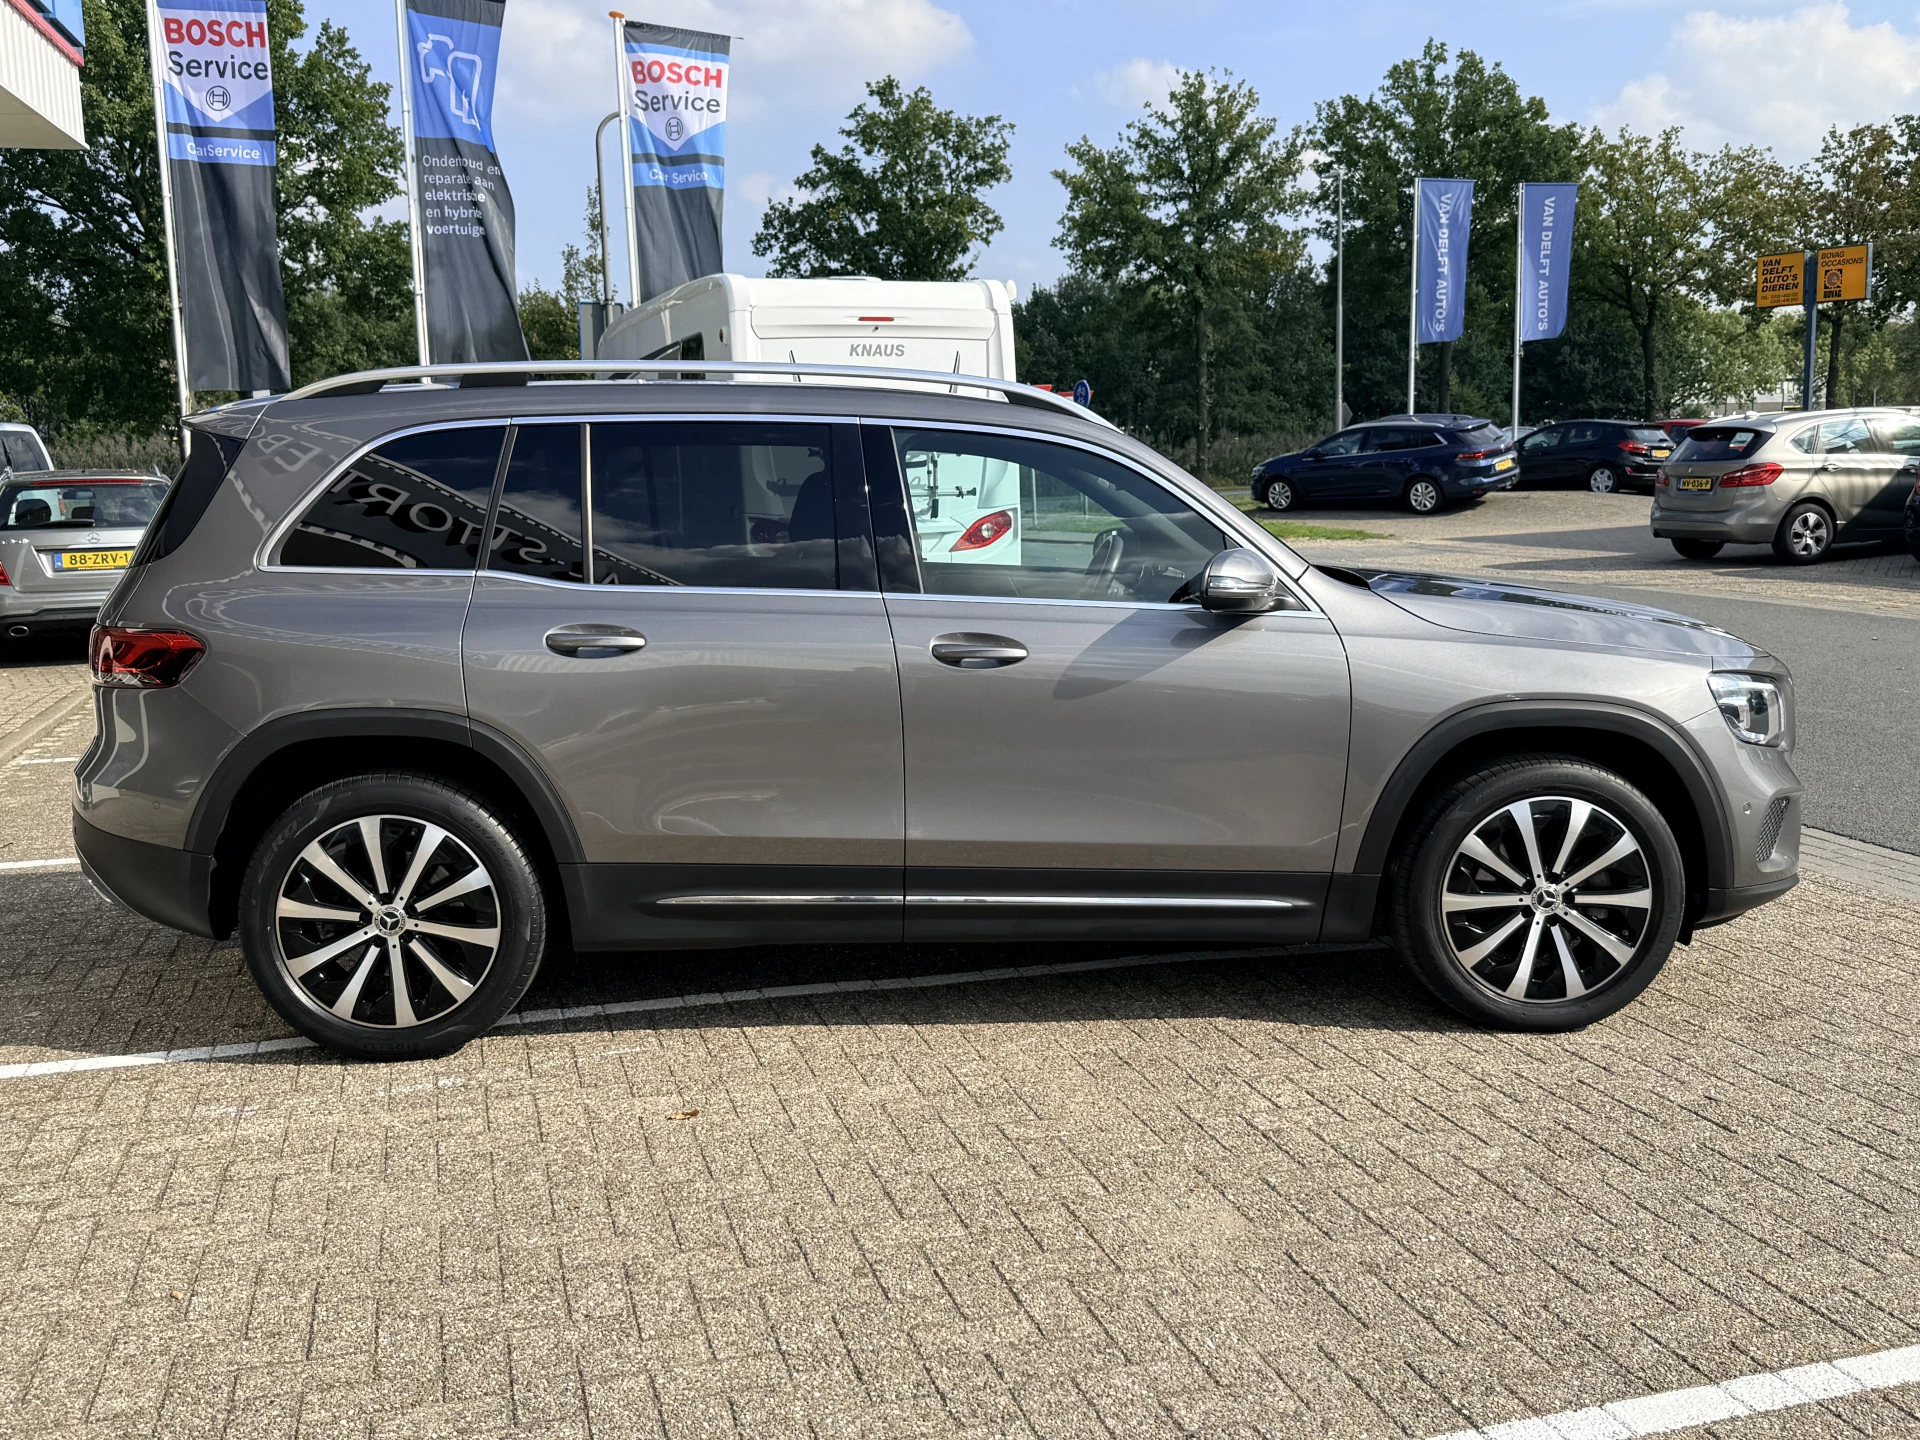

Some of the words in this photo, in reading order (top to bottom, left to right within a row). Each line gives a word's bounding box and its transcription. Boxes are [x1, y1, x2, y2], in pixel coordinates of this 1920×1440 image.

[164, 17, 267, 48] BOSCH
[168, 51, 269, 81] Service
[632, 60, 722, 88] BOSCH
[634, 90, 720, 114] Service
[487, 165, 501, 176] en
[649, 168, 669, 181] Car
[671, 169, 709, 184] Service
[474, 176, 495, 191] aan
[425, 208, 441, 218] en
[1439, 193, 1452, 224] VAN
[1542, 196, 1555, 227] VAN
[1437, 228, 1449, 275] DELFT
[1539, 231, 1553, 276] DELFT
[1821, 251, 1845, 260] BOVAG
[1762, 258, 1782, 267] VAN
[1821, 256, 1864, 268] OCCASIONS
[1762, 265, 1795, 276] DELFT
[1762, 273, 1798, 284] AUTO'S
[1761, 282, 1799, 293] DIEREN
[1435, 279, 1447, 332] AUTO'S
[1538, 279, 1549, 331] AUTO'S
[849, 343, 905, 357] KNAUS
[69, 553, 129, 566] 88-ZRV-1
